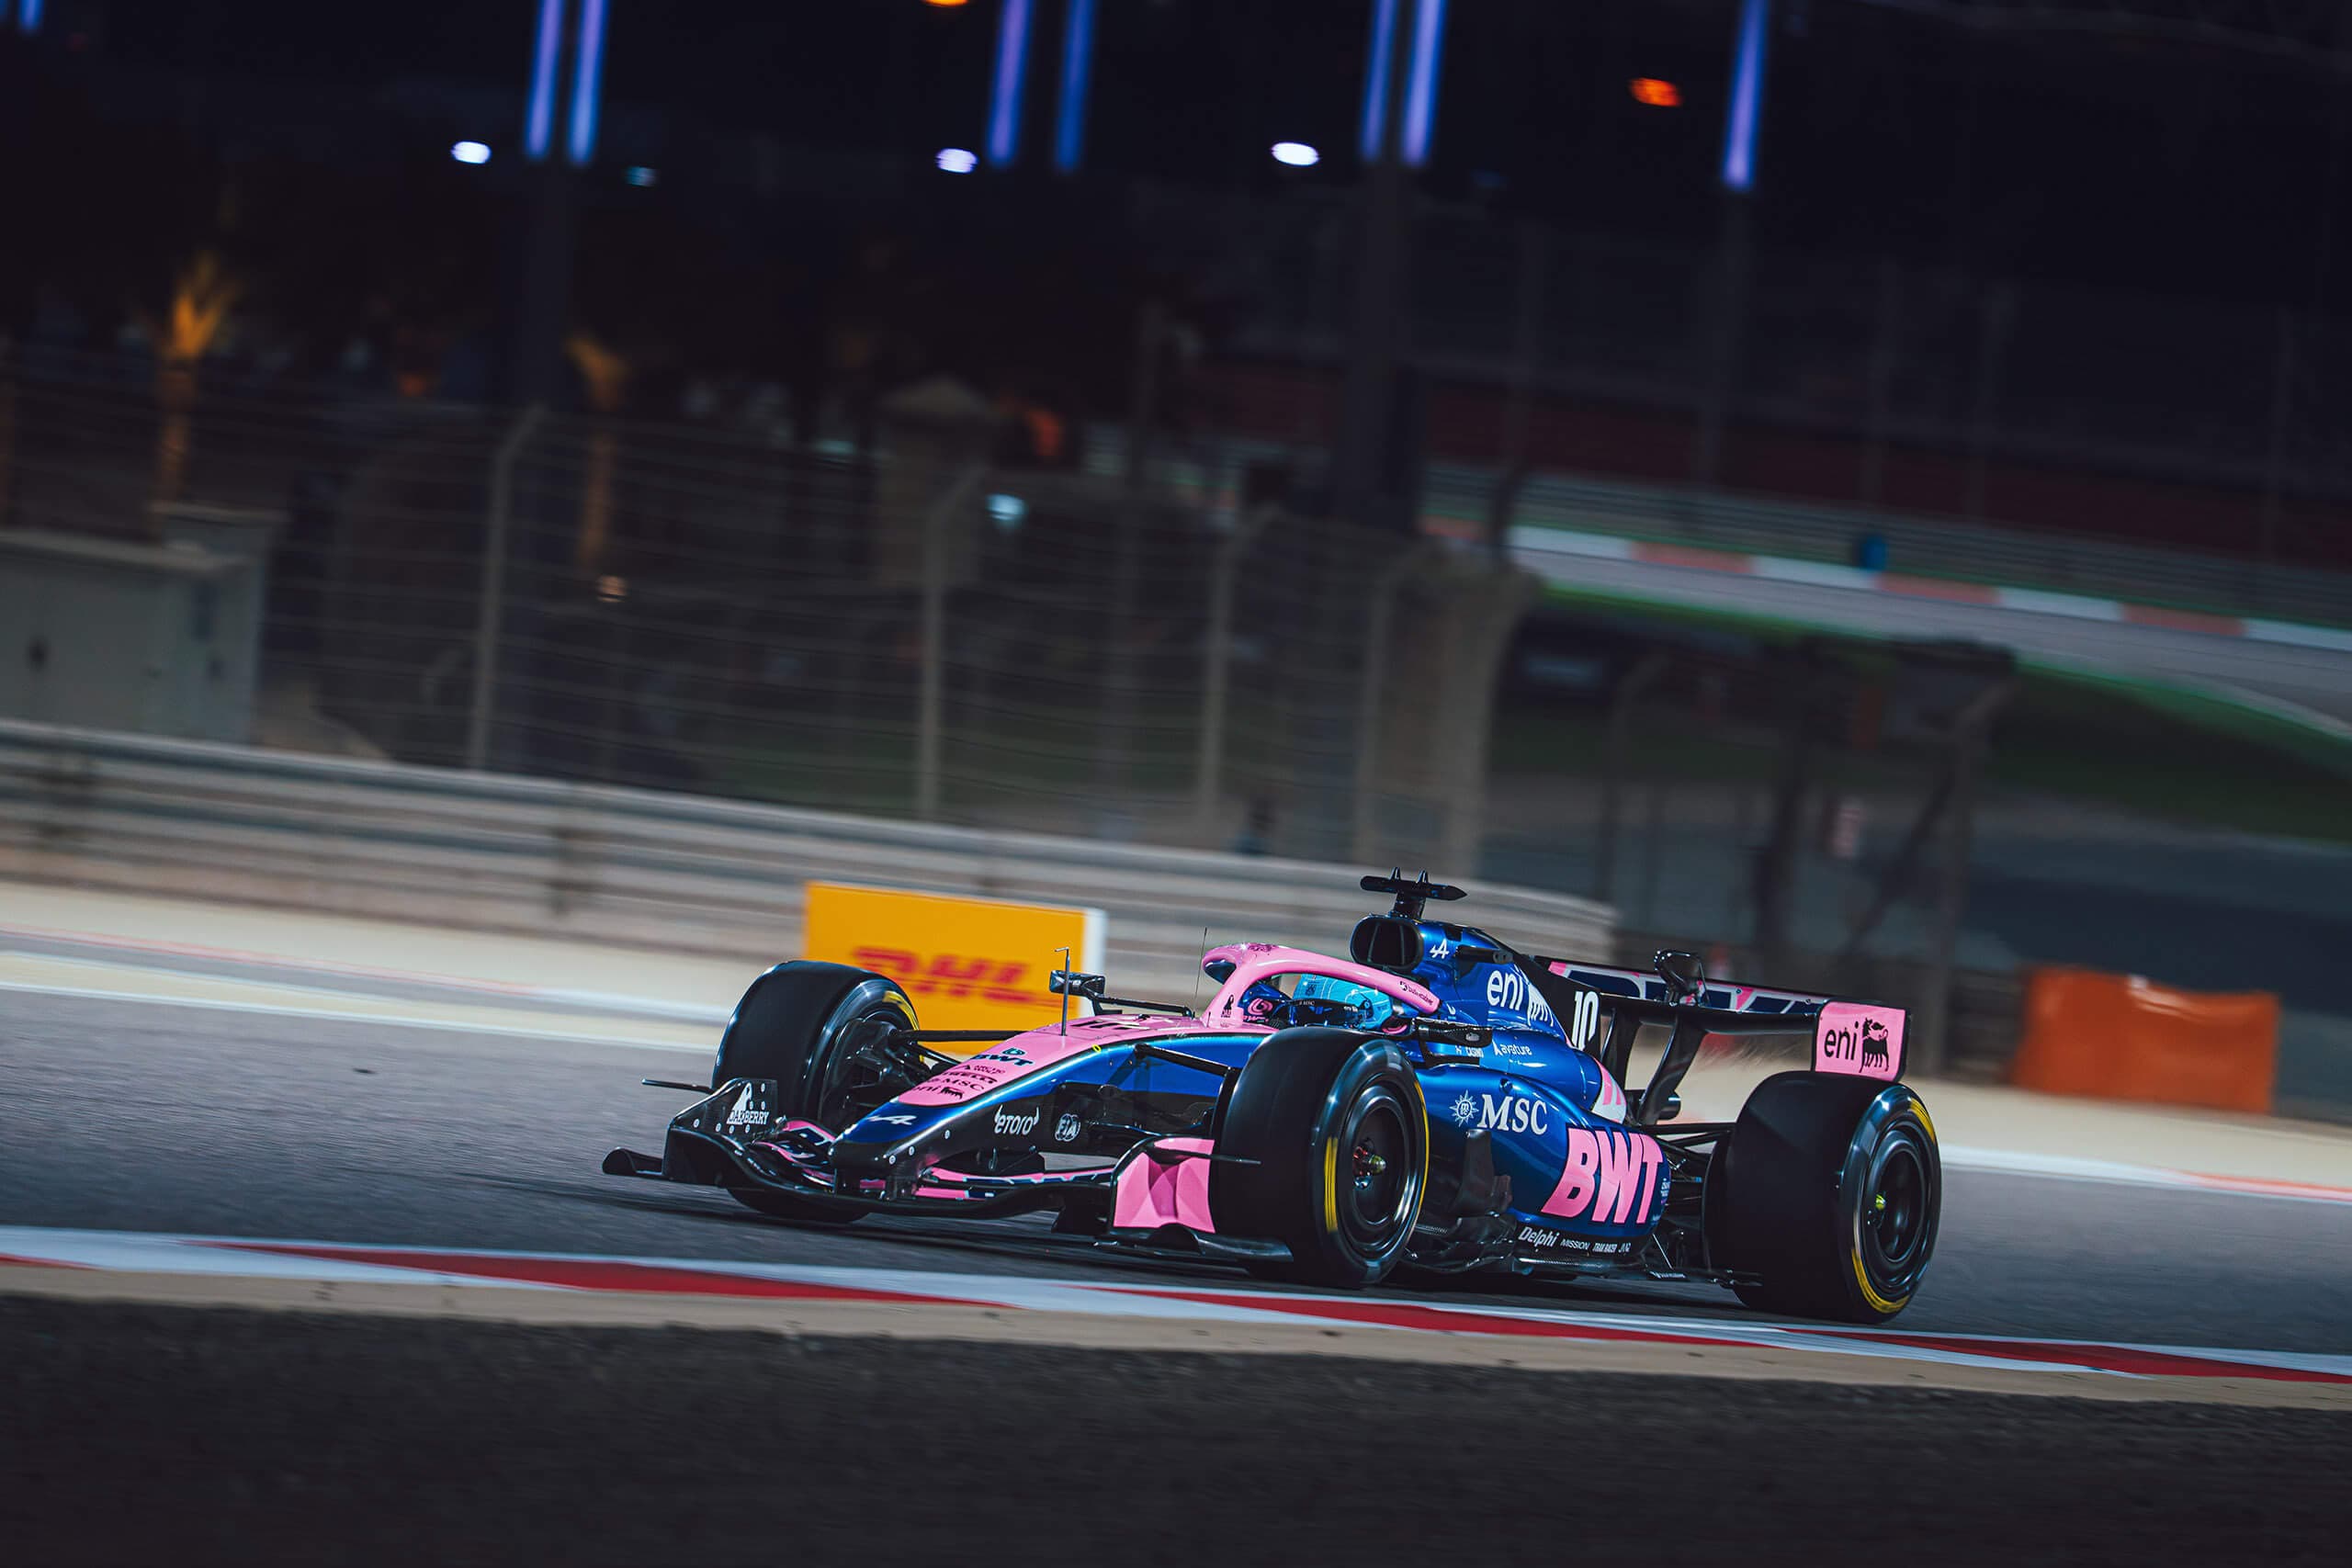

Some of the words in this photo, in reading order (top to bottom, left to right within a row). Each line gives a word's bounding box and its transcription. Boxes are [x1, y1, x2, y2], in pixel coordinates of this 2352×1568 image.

[1487, 967, 1524, 1010] eni
[1572, 991, 1599, 1052] 10
[1824, 1021, 1859, 1061] eni
[1477, 1094, 1547, 1135] MSC
[1540, 1127, 1663, 1224] BWT
[1518, 1226, 1560, 1248] Delphi
[1560, 1238, 1591, 1250] MISSION
